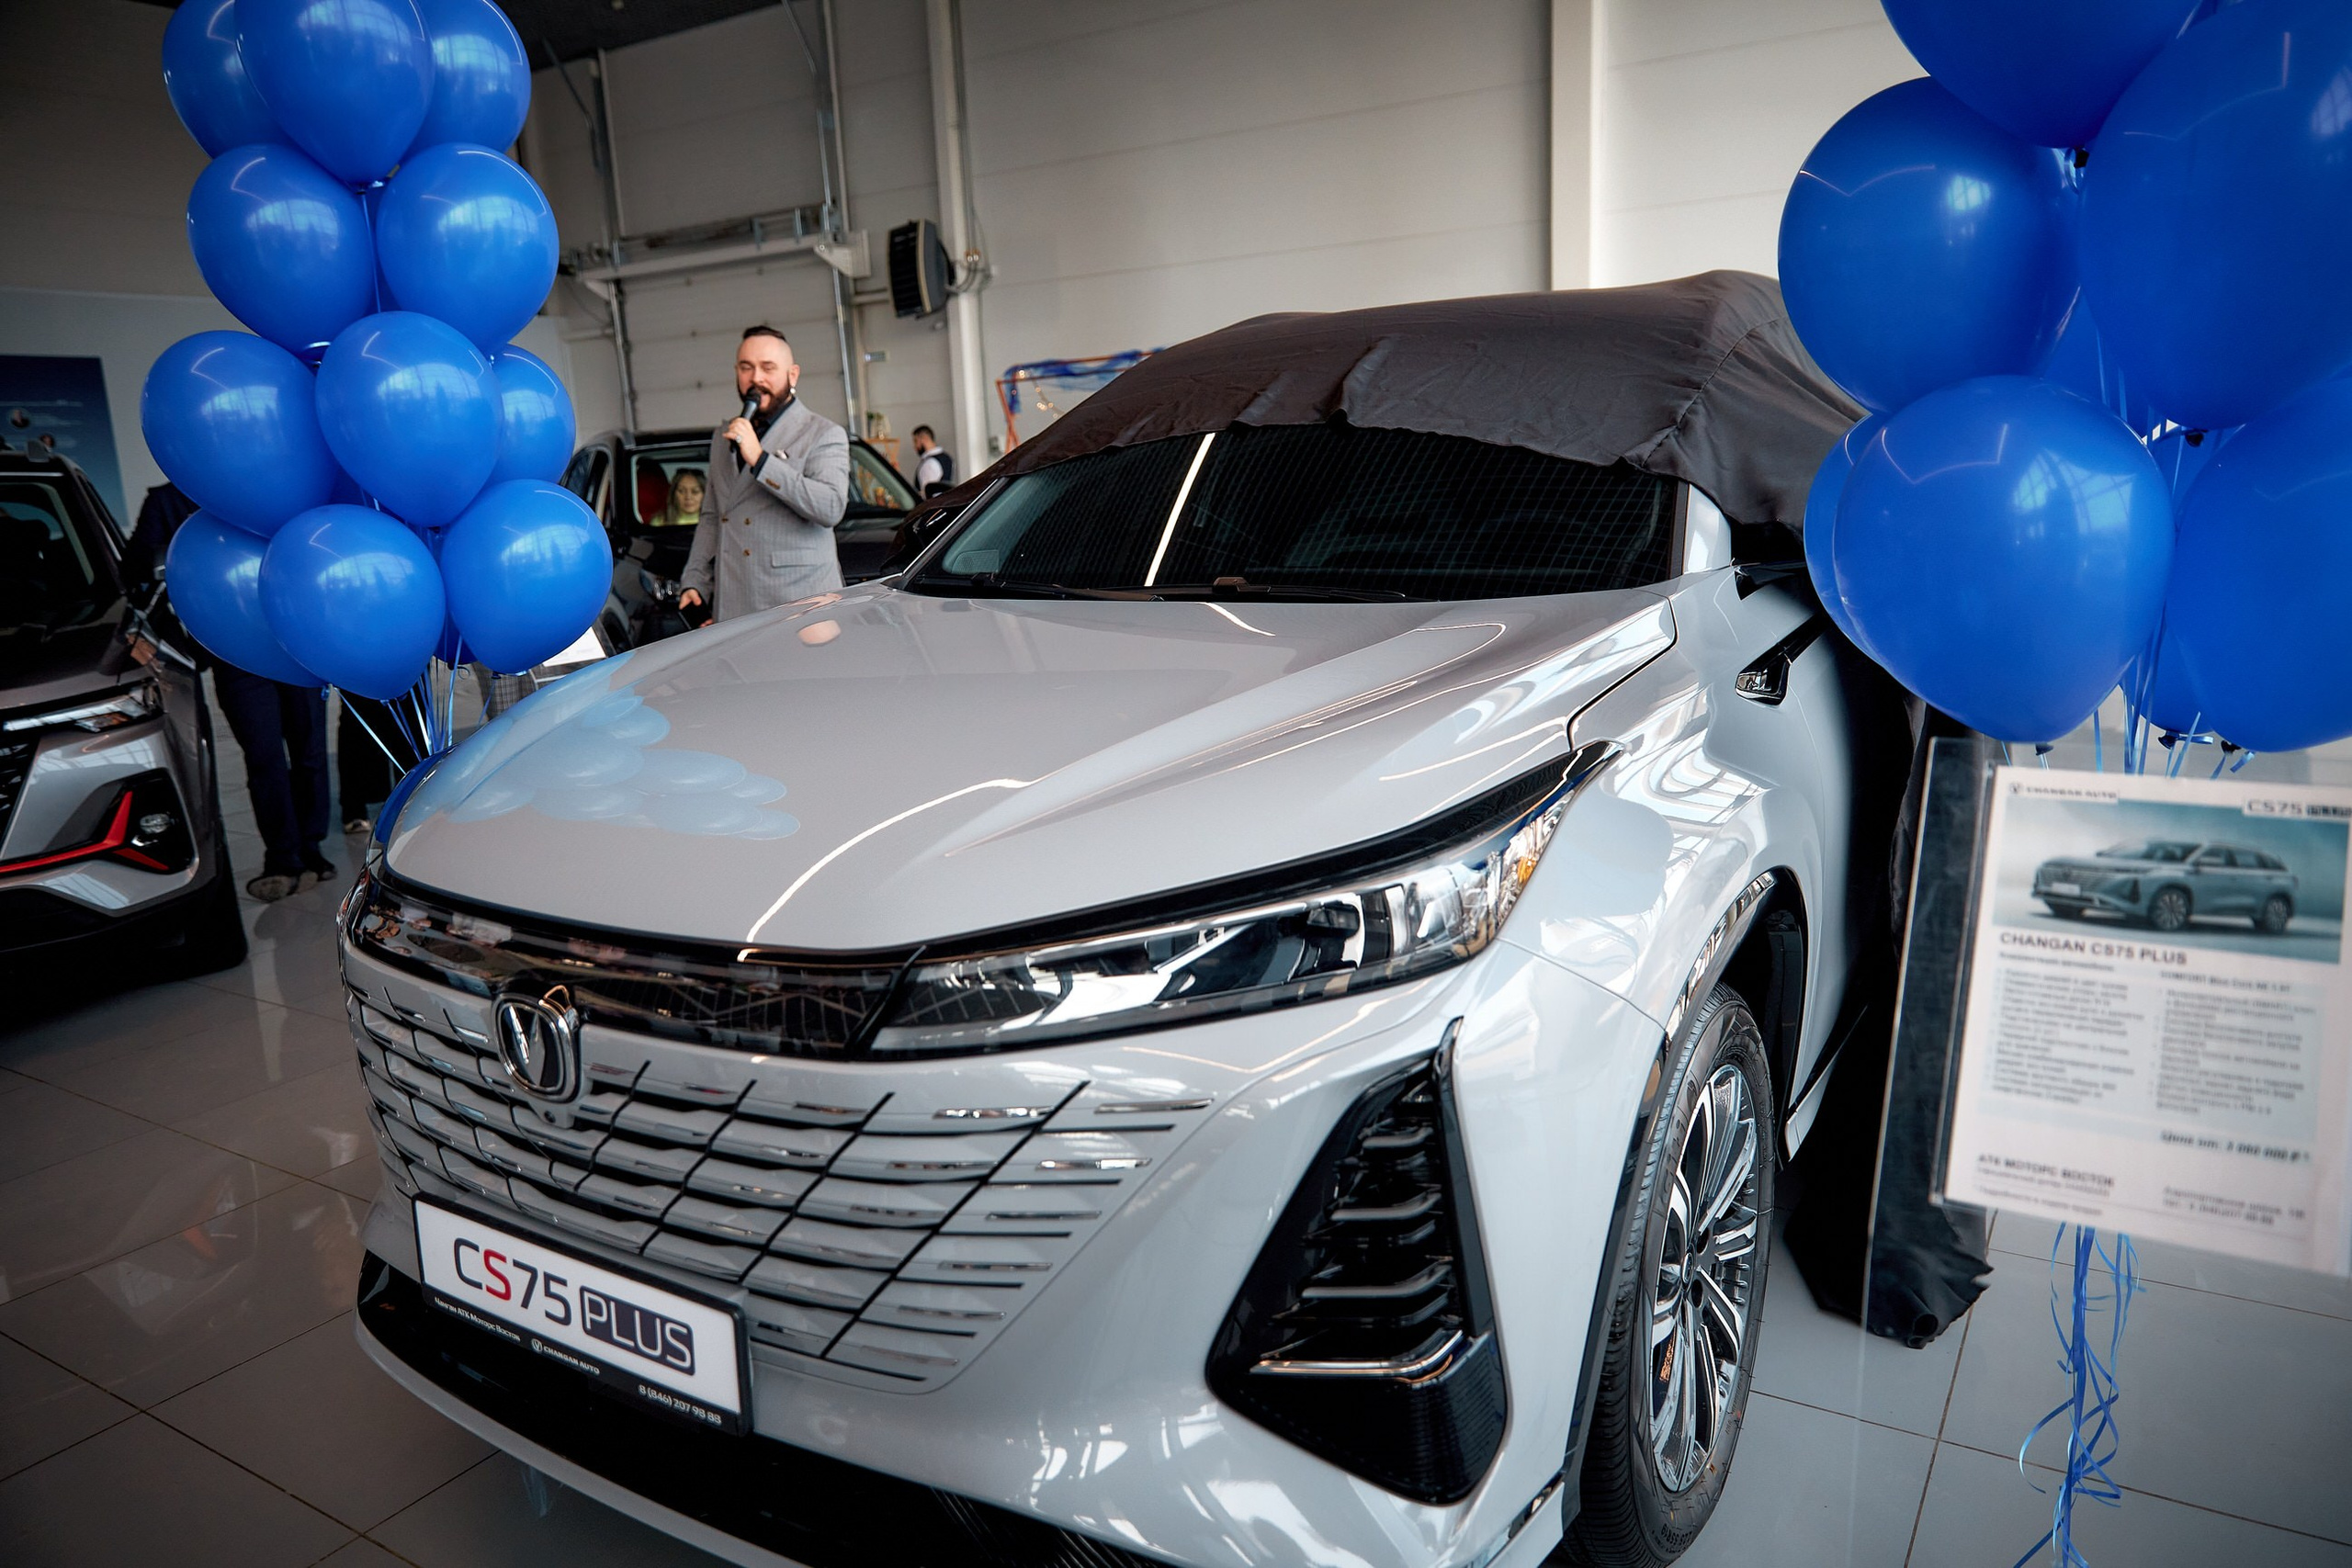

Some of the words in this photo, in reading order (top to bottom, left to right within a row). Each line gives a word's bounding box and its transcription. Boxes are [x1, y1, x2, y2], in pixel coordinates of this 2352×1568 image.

[2000, 931, 2086, 953] CHANGAN
[2090, 942, 2135, 959] CS75
[2140, 947, 2188, 965] PLUS
[454, 1237, 571, 1325] CS75
[584, 1294, 691, 1369] PLUS
[470, 1314, 496, 1331] Моторс
[496, 1325, 521, 1343] Восток
[543, 1345, 579, 1366] CHANGAN
[579, 1360, 600, 1375] AUTO
[639, 1384, 646, 1395] 8
[647, 1387, 673, 1406] (846)
[673, 1398, 691, 1413] 207
[691, 1405, 707, 1419] 98
[707, 1411, 722, 1426] 88
